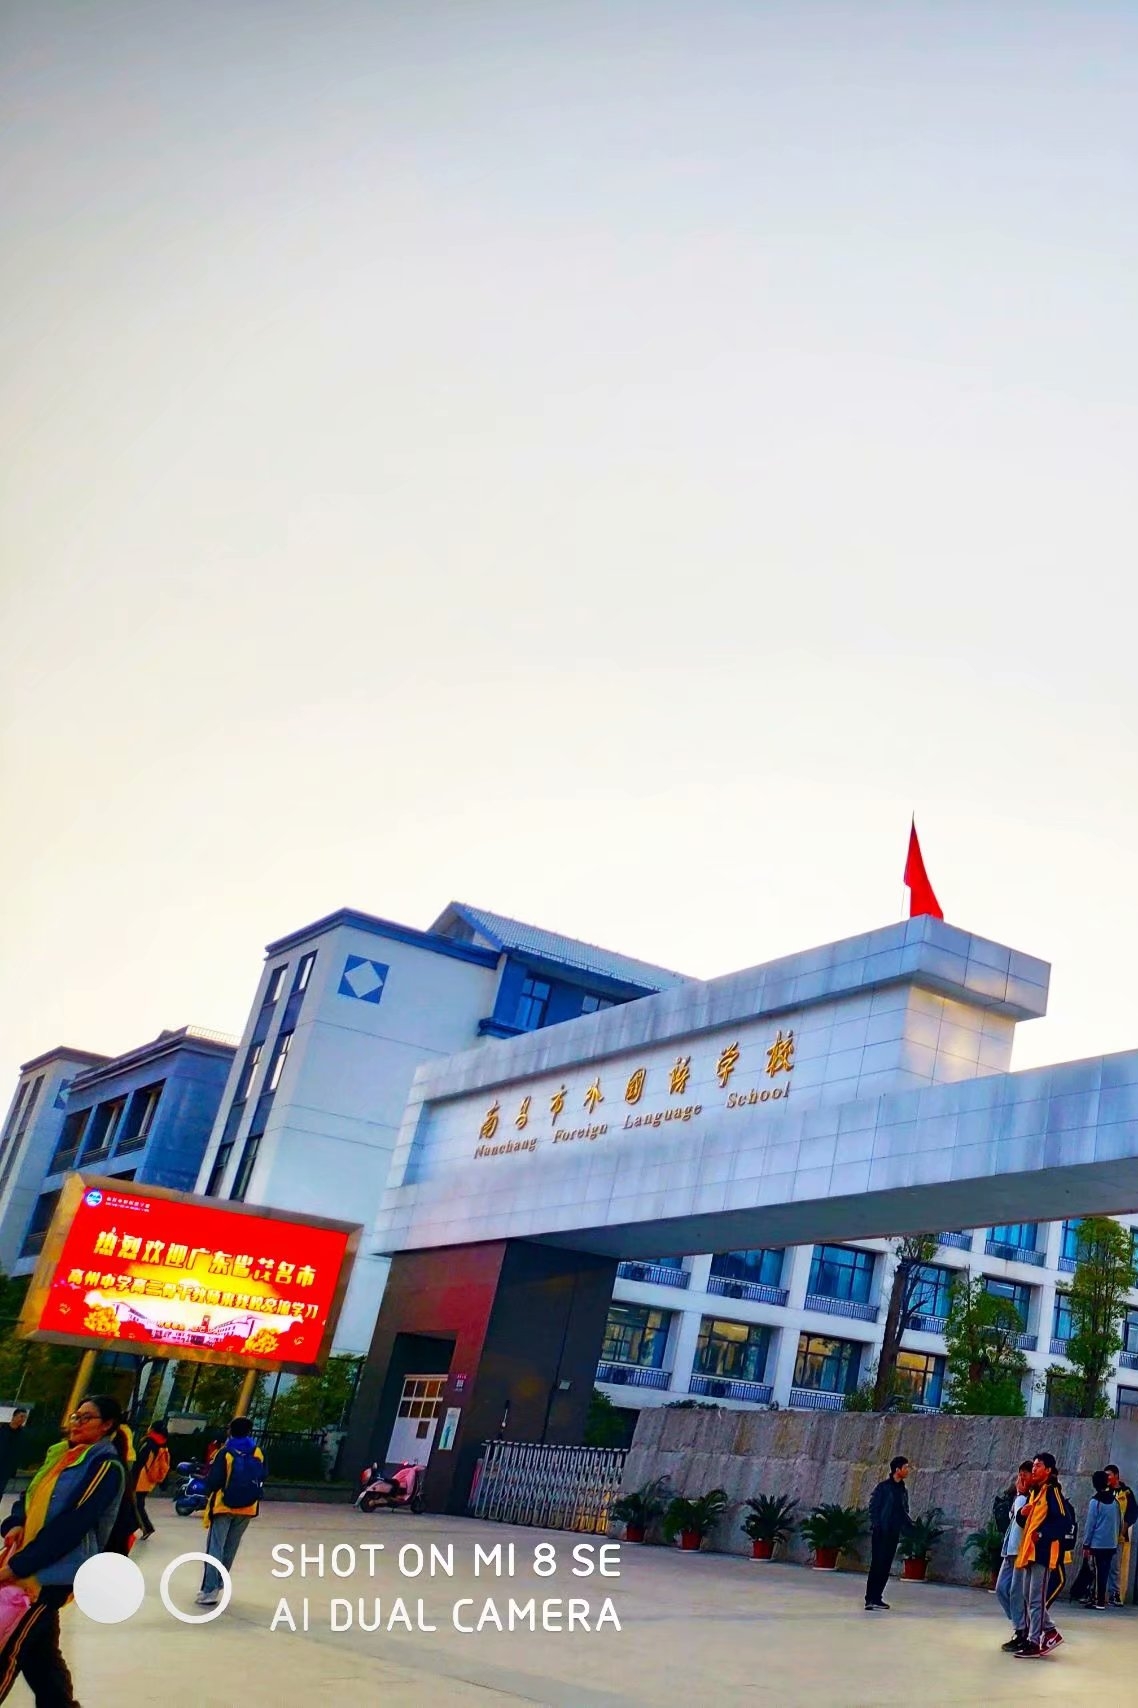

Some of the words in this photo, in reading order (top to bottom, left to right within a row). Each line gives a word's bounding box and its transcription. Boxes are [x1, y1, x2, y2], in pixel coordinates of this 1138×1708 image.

[474, 1138, 538, 1159] Nanchang
[552, 1123, 608, 1144] Foreign
[622, 1104, 703, 1130] Language
[725, 1081, 791, 1109] School
[94, 1229, 316, 1287] 热烈欢迎广东省茂名市
